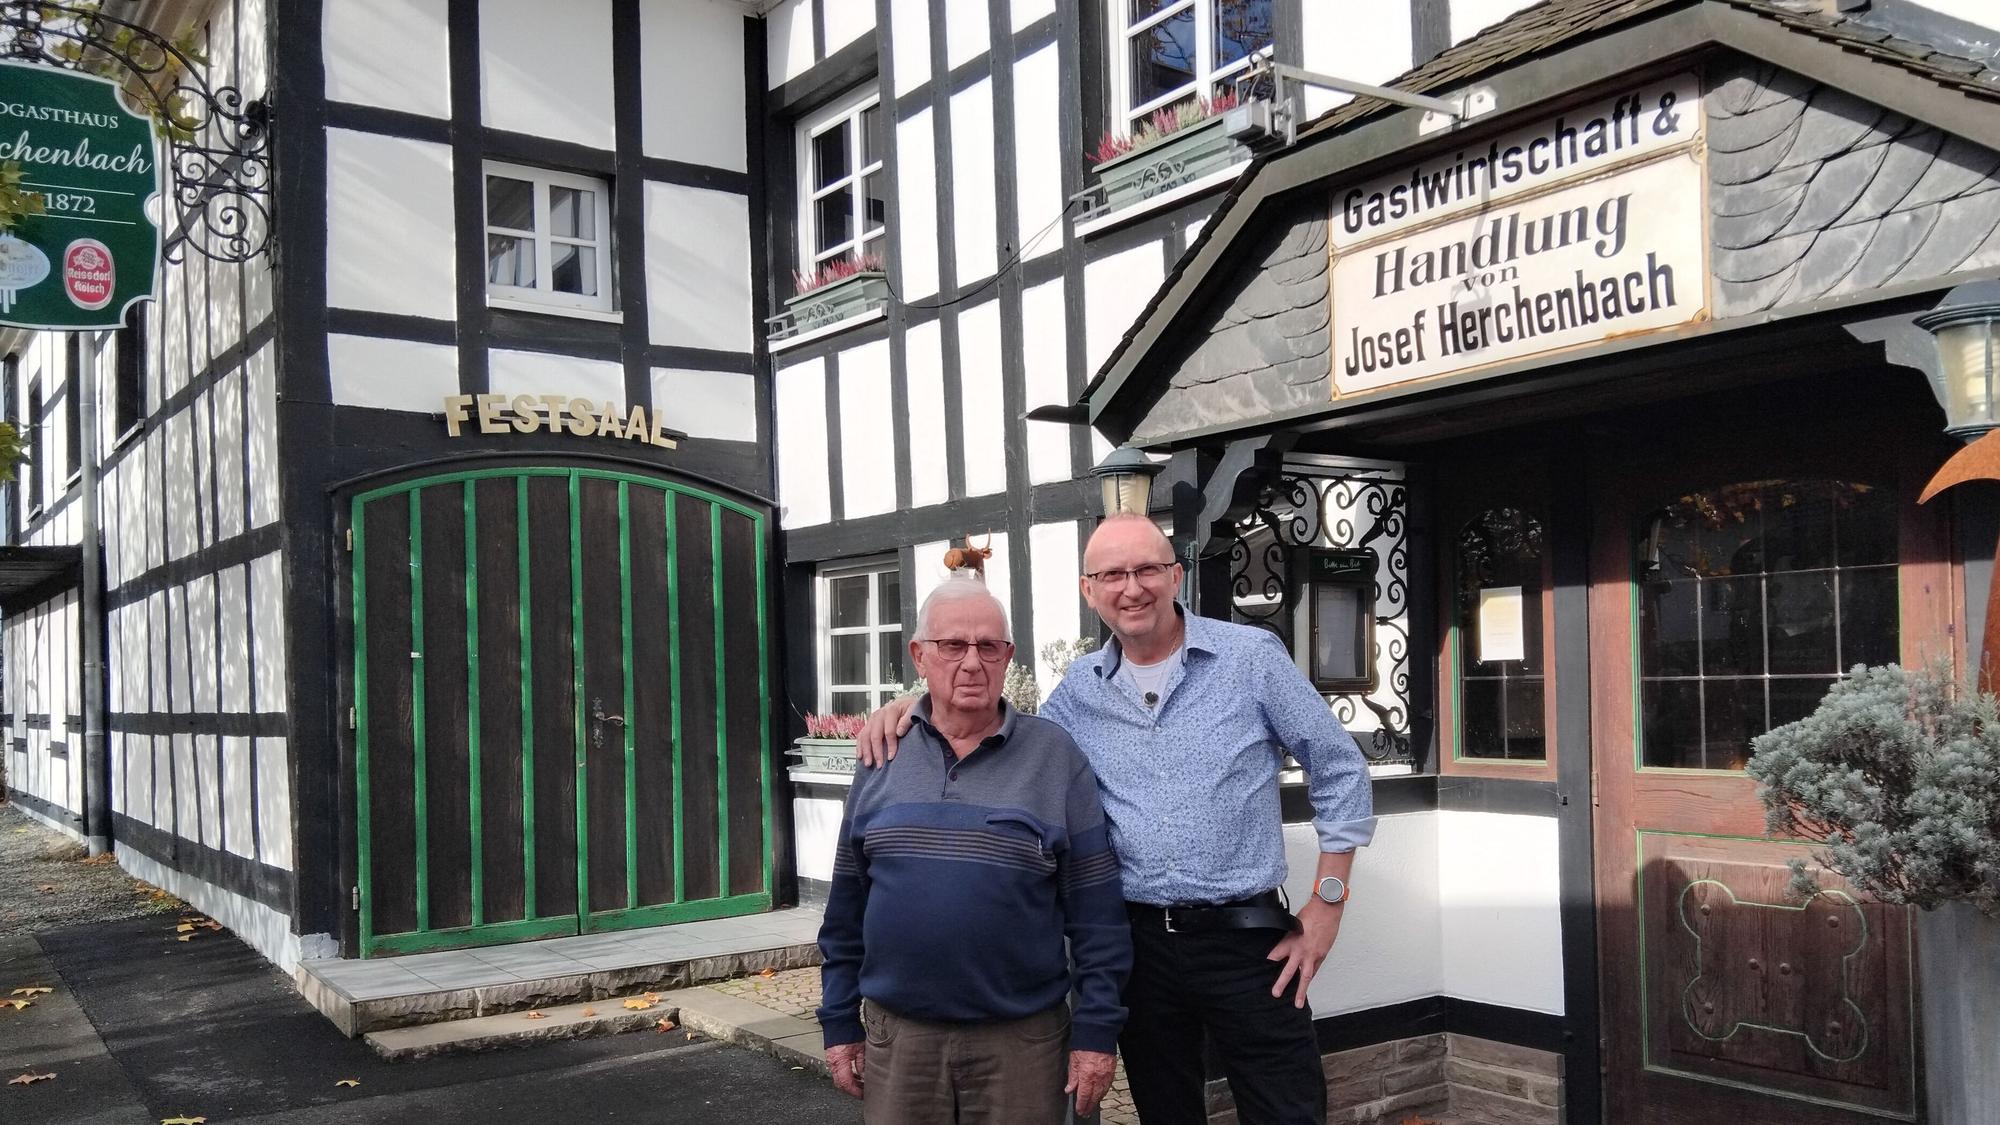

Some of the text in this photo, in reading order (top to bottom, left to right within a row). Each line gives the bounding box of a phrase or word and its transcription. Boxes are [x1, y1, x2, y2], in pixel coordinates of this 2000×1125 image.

[1343, 91, 1681, 234] Gastwirtschaft &
[45, 193, 96, 214] 1872
[1372, 193, 1634, 299] Handlung
[1464, 265, 1520, 292] von
[1345, 251, 1678, 377] Josef Herchenbach
[444, 394, 677, 449] FESTSAAL
